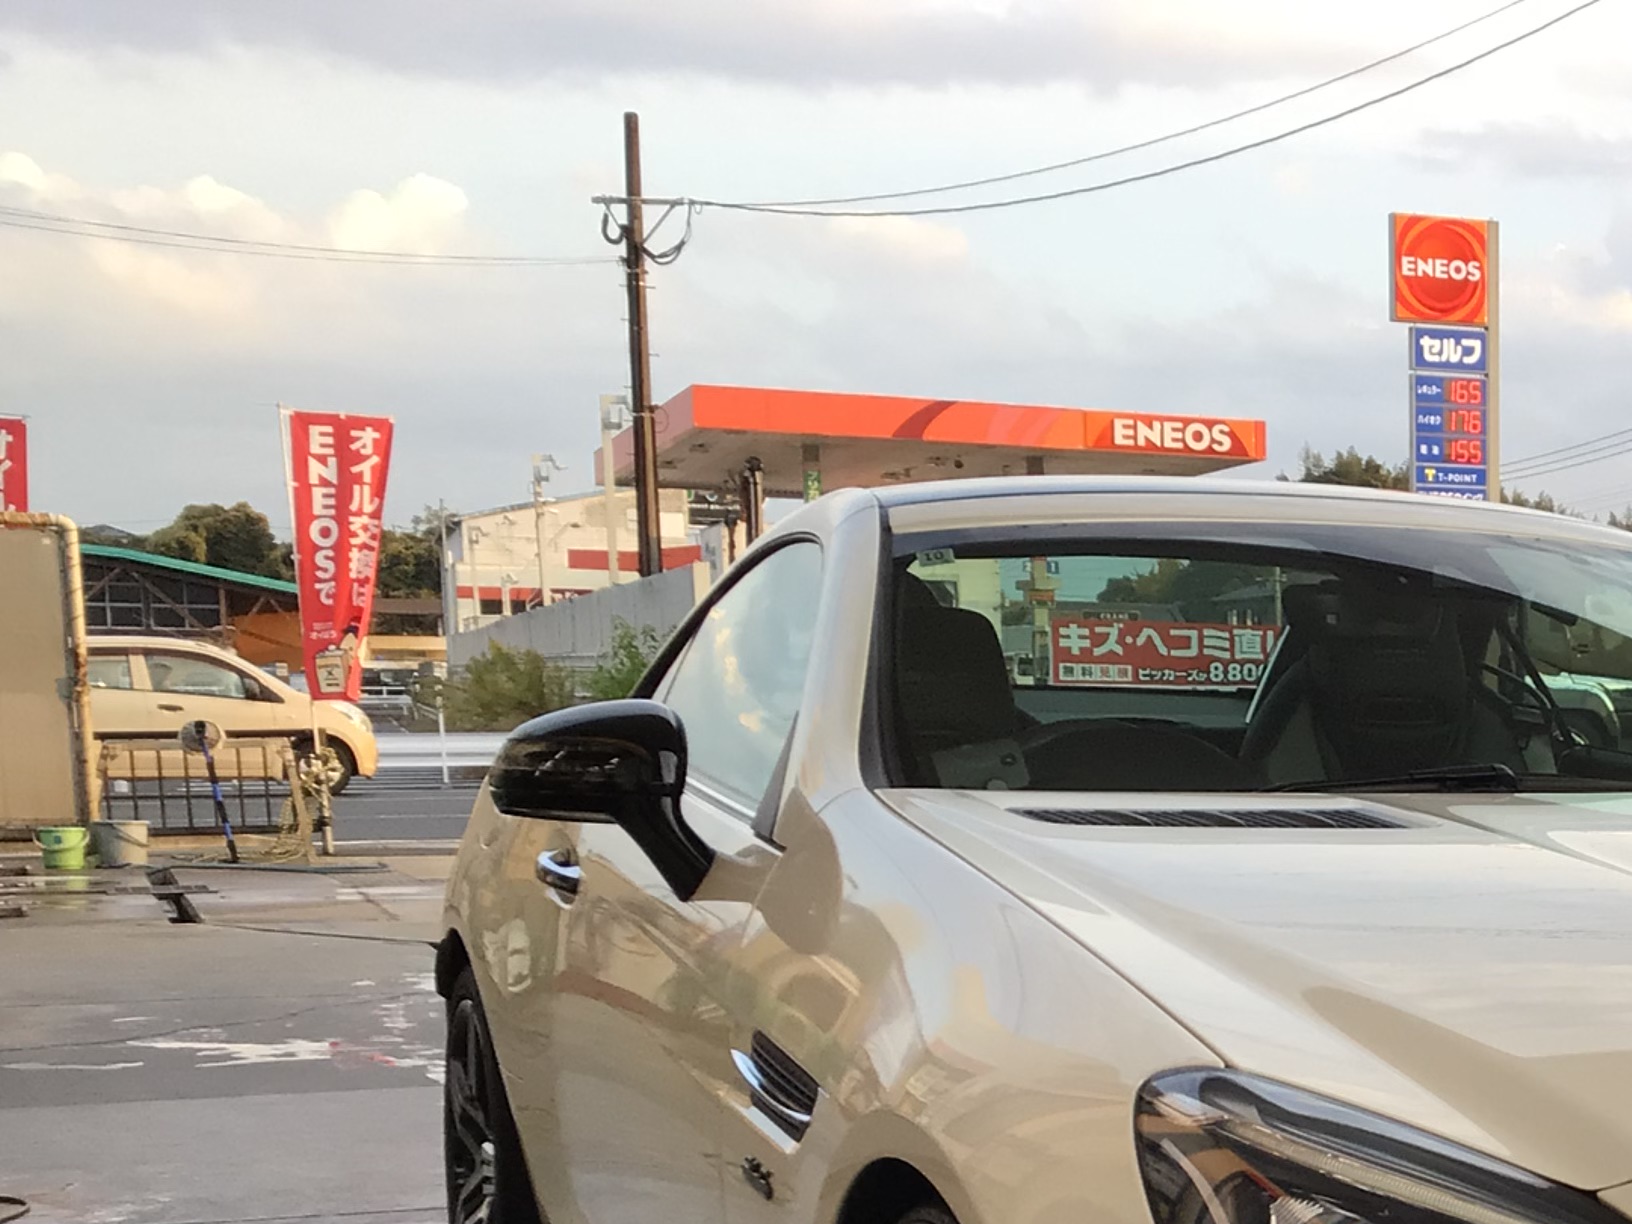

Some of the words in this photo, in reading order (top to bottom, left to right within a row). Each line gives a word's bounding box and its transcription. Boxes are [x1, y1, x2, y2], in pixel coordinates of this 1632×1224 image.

[1401, 254, 1481, 283] ENEOS
[1419, 335, 1482, 364] セルフ
[1451, 379, 1482, 404] 165
[1113, 416, 1232, 453] ENEOS
[1451, 410, 1481, 434] 176
[1451, 440, 1482, 464] 155
[1438, 472, 1477, 483] T-POINT
[307, 424, 339, 606] ENEOSで
